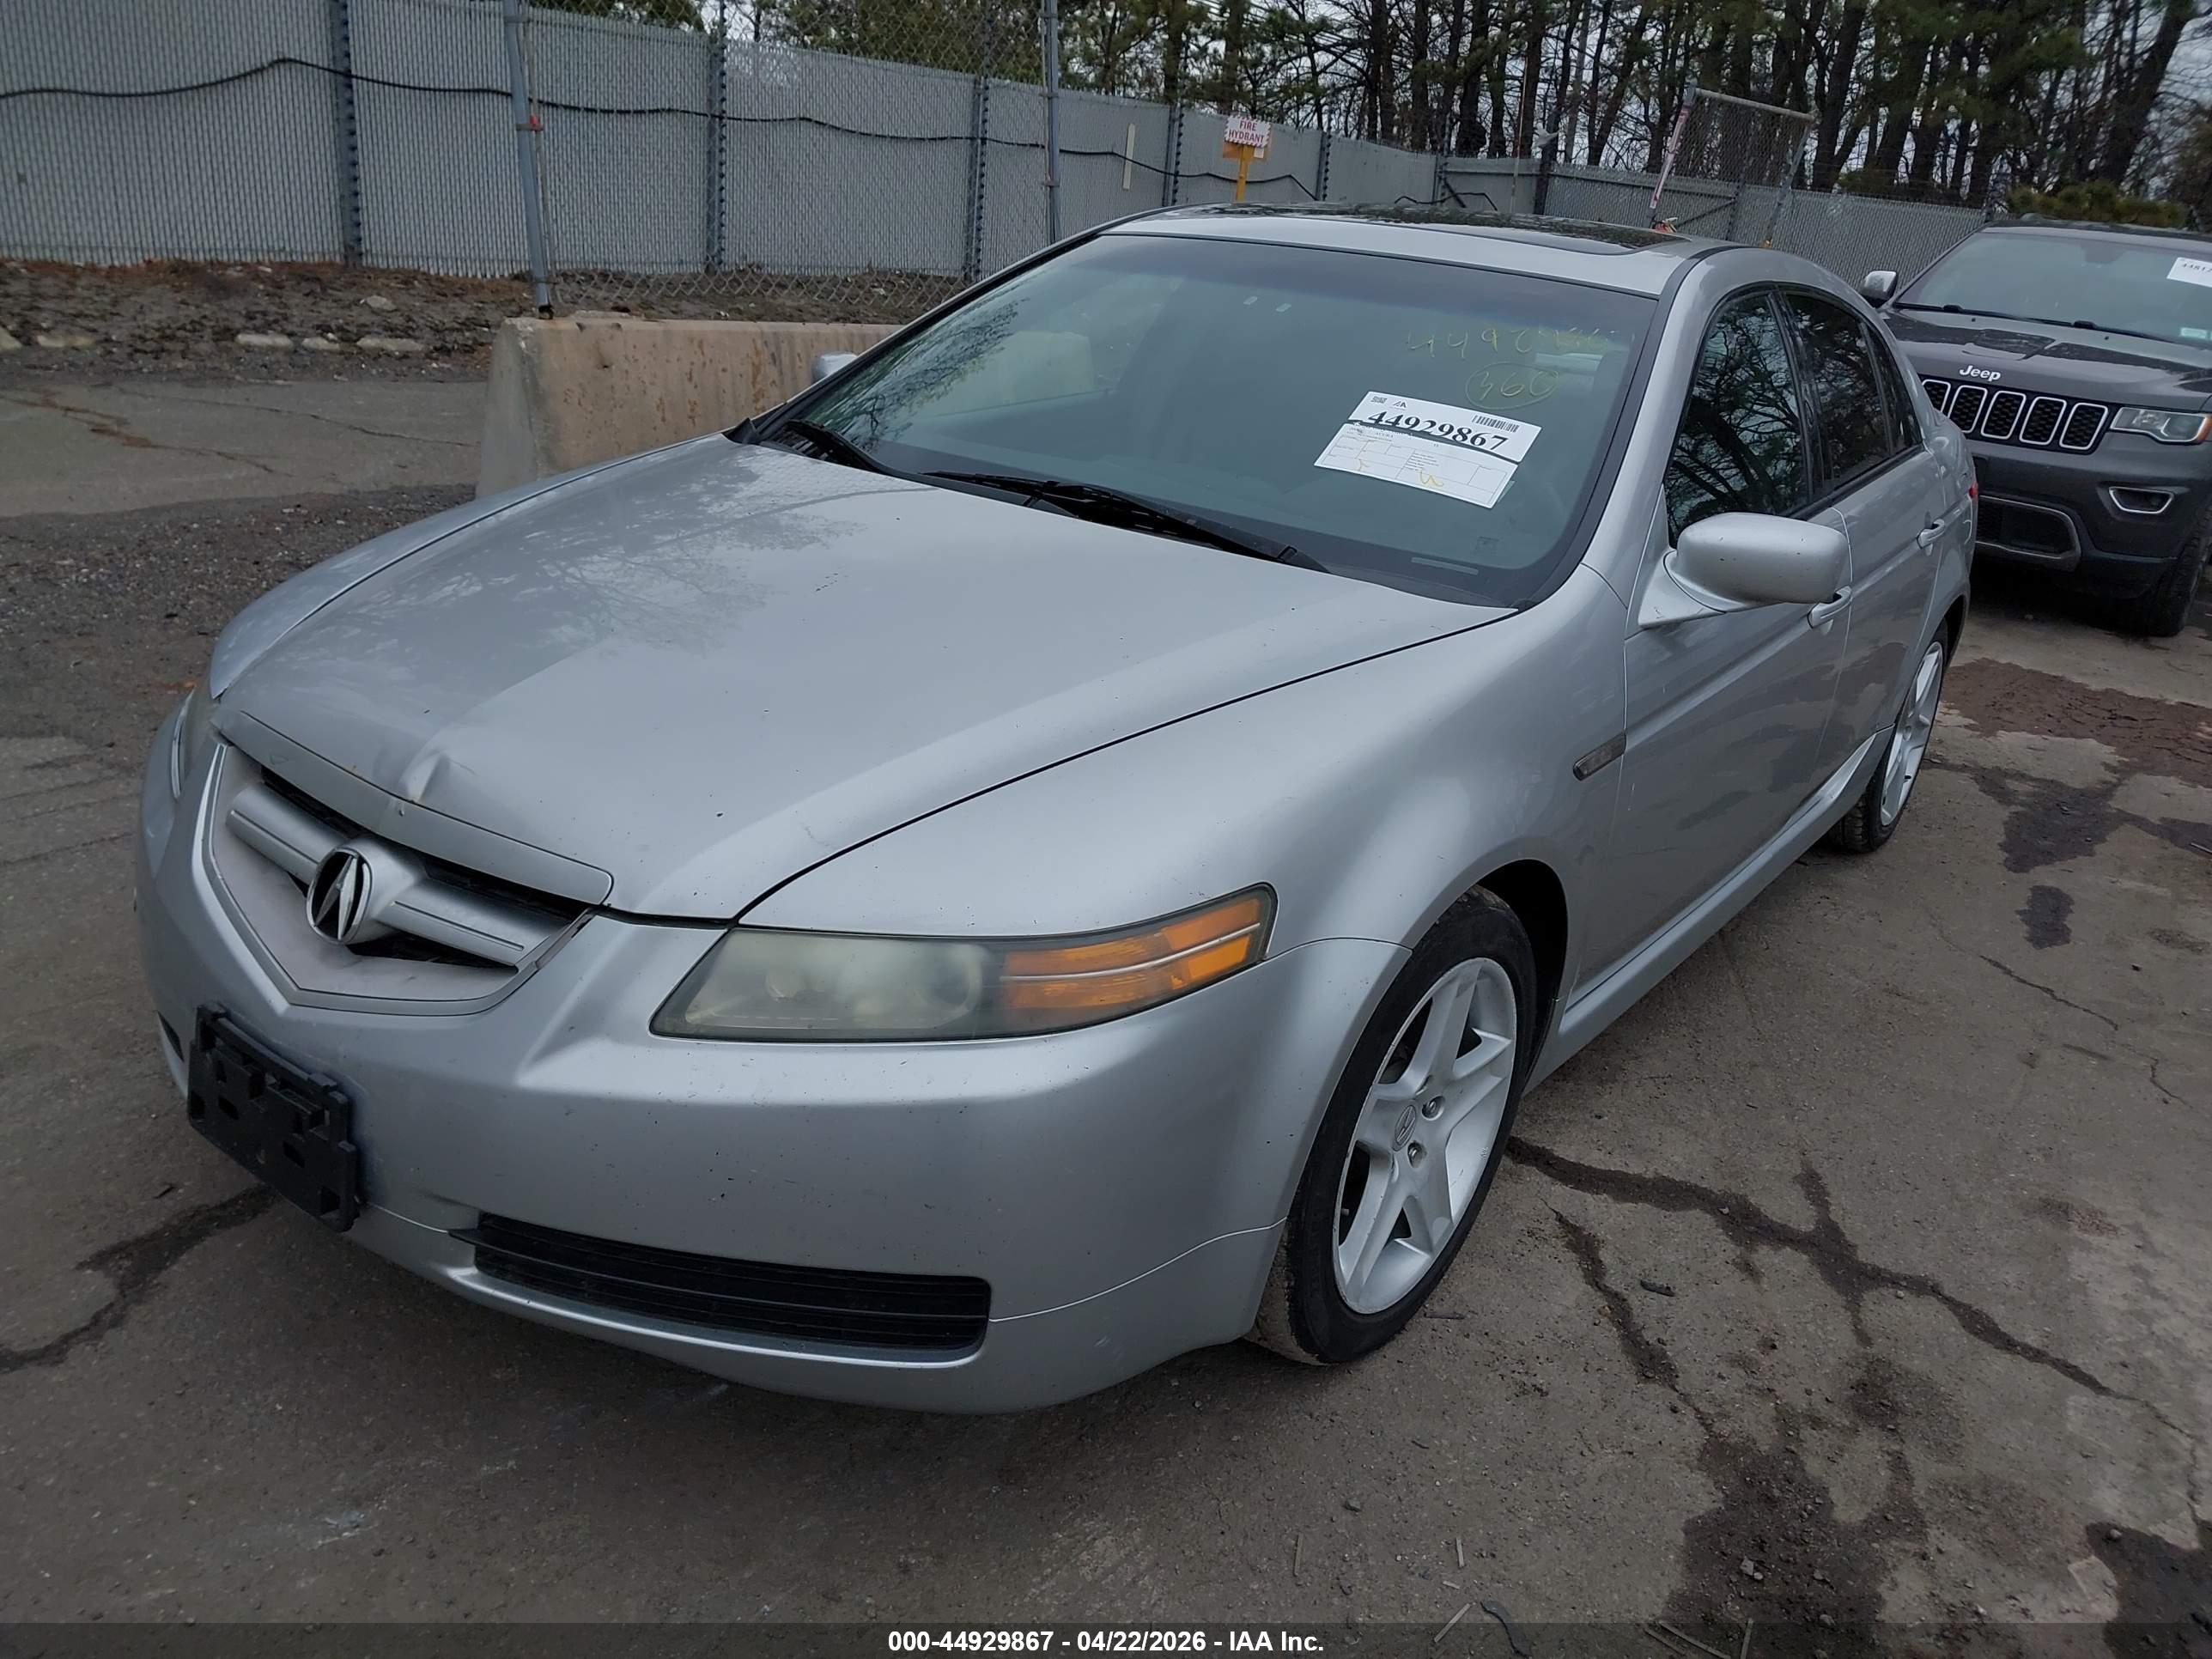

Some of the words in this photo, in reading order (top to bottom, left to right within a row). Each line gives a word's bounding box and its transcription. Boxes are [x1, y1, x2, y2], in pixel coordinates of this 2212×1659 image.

[1239, 120, 1257, 131] FIRE
[1229, 129, 1264, 143] HYDRANT
[1959, 365, 2001, 382] Jeep
[1368, 410, 1509, 451] 44929867
